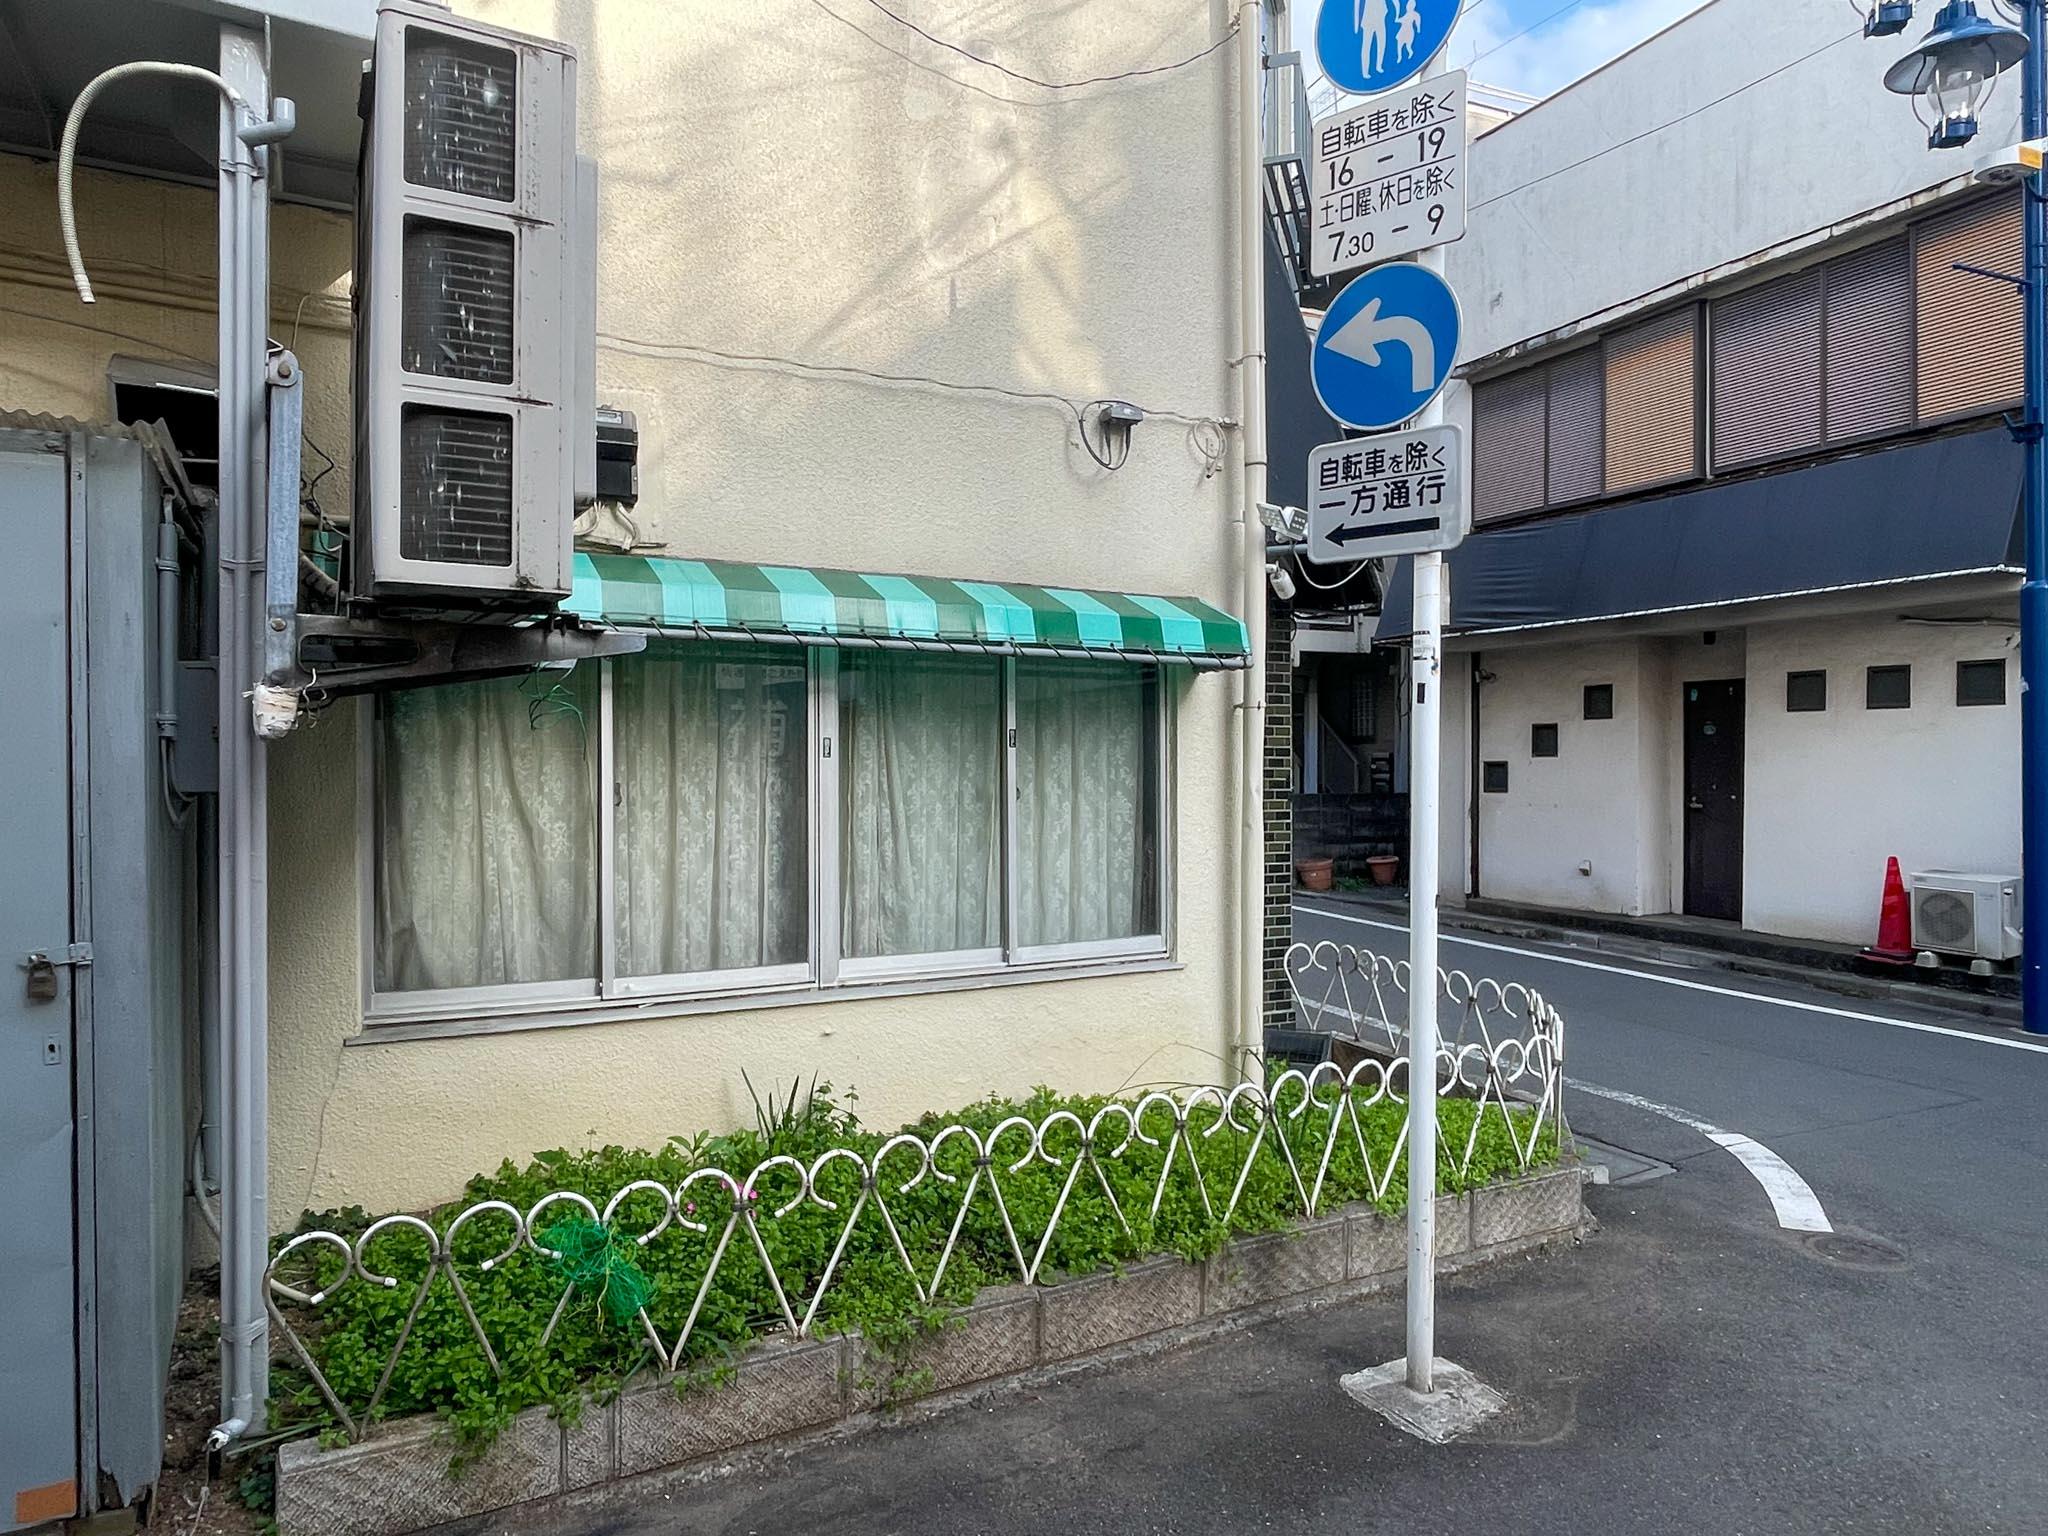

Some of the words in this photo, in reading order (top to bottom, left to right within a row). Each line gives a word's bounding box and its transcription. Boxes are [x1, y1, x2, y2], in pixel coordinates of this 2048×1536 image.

[1321, 90, 1455, 157] 自転車を除く
[1329, 157, 1354, 190] 16
[1418, 127, 1445, 162] 19
[1427, 203, 1445, 235] 9
[1320, 441, 1445, 486] 自転車を除く
[1319, 475, 1446, 516] 一方通行
